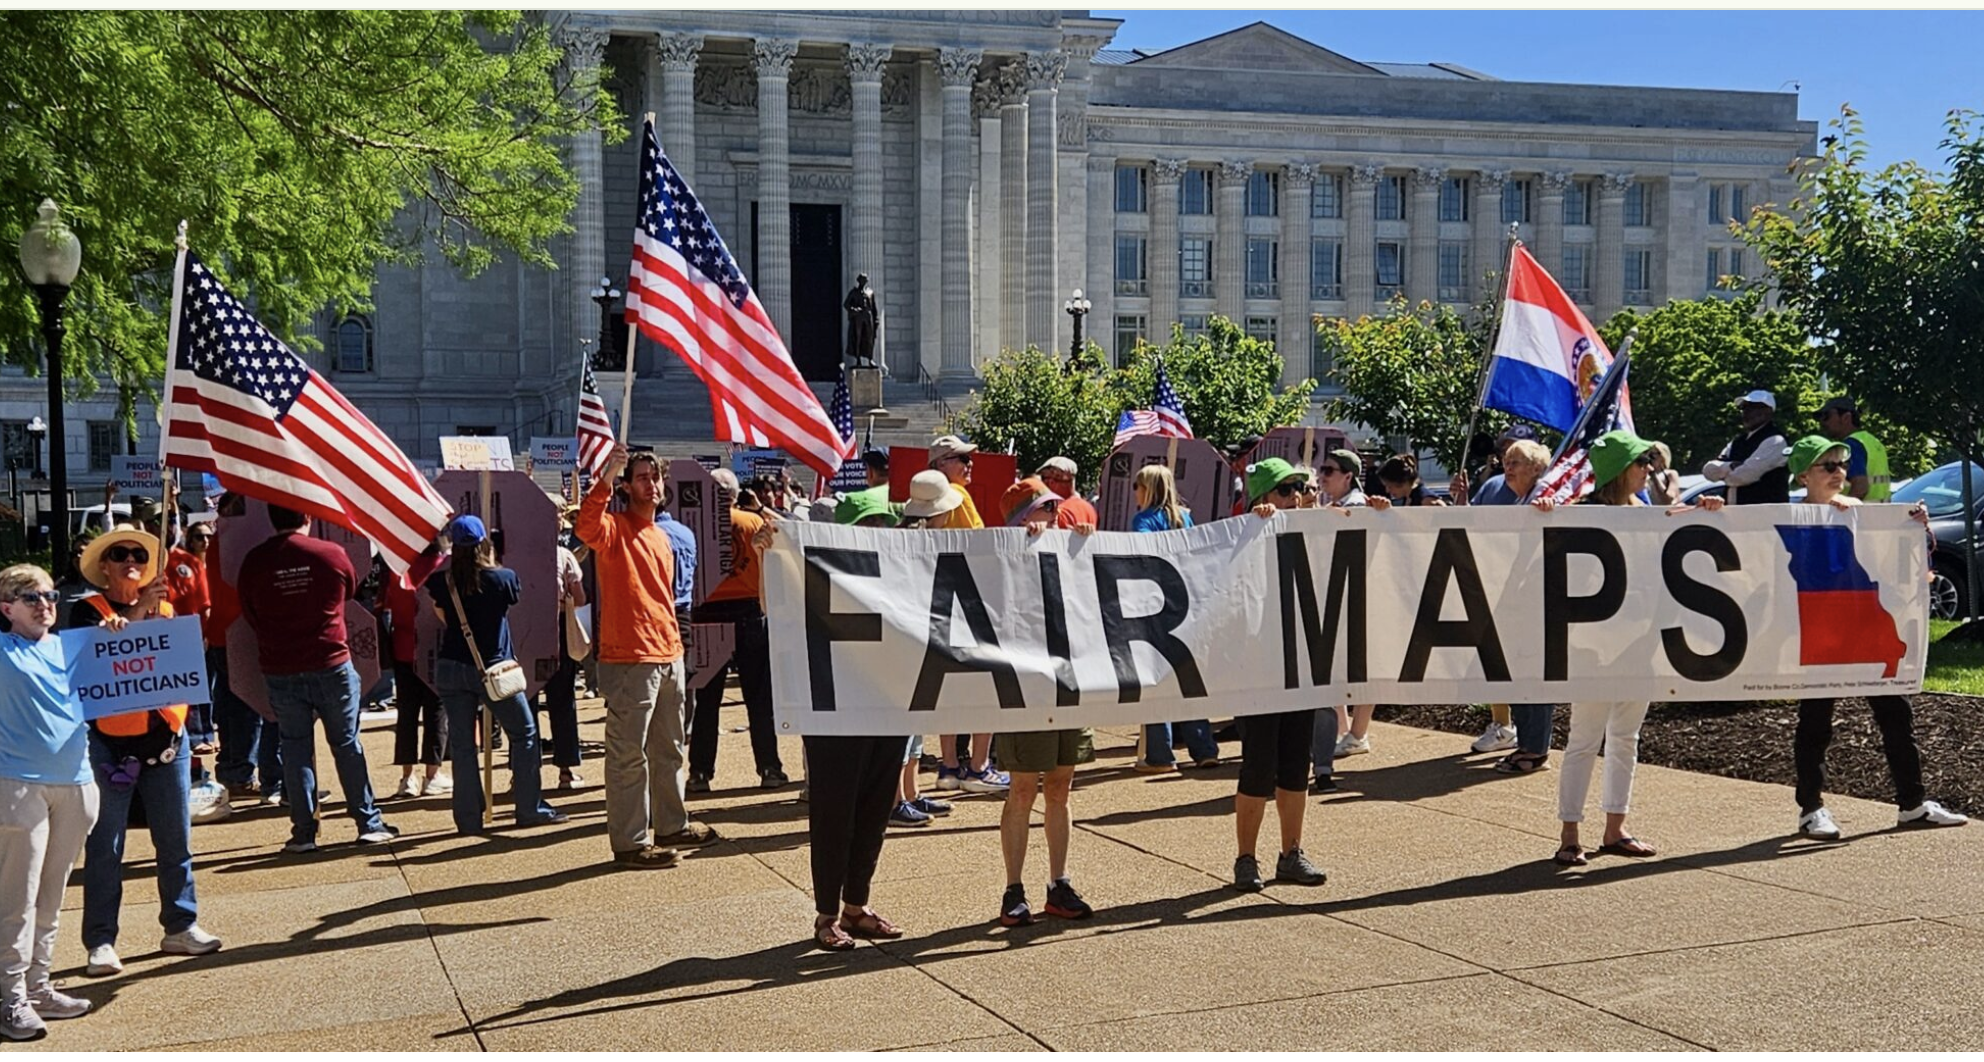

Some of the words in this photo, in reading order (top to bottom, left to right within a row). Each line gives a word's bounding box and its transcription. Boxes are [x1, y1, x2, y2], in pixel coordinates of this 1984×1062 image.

[115, 480, 163, 488] POLITICIAN
[132, 471, 153, 479] NOT
[717, 486, 732, 547] OAMULAR
[804, 545, 1208, 711] FAIR
[1276, 525, 1748, 690] MAPS
[95, 634, 171, 658] PEOPLE
[112, 656, 157, 676] NOT
[77, 671, 200, 702] POLITICIANS
